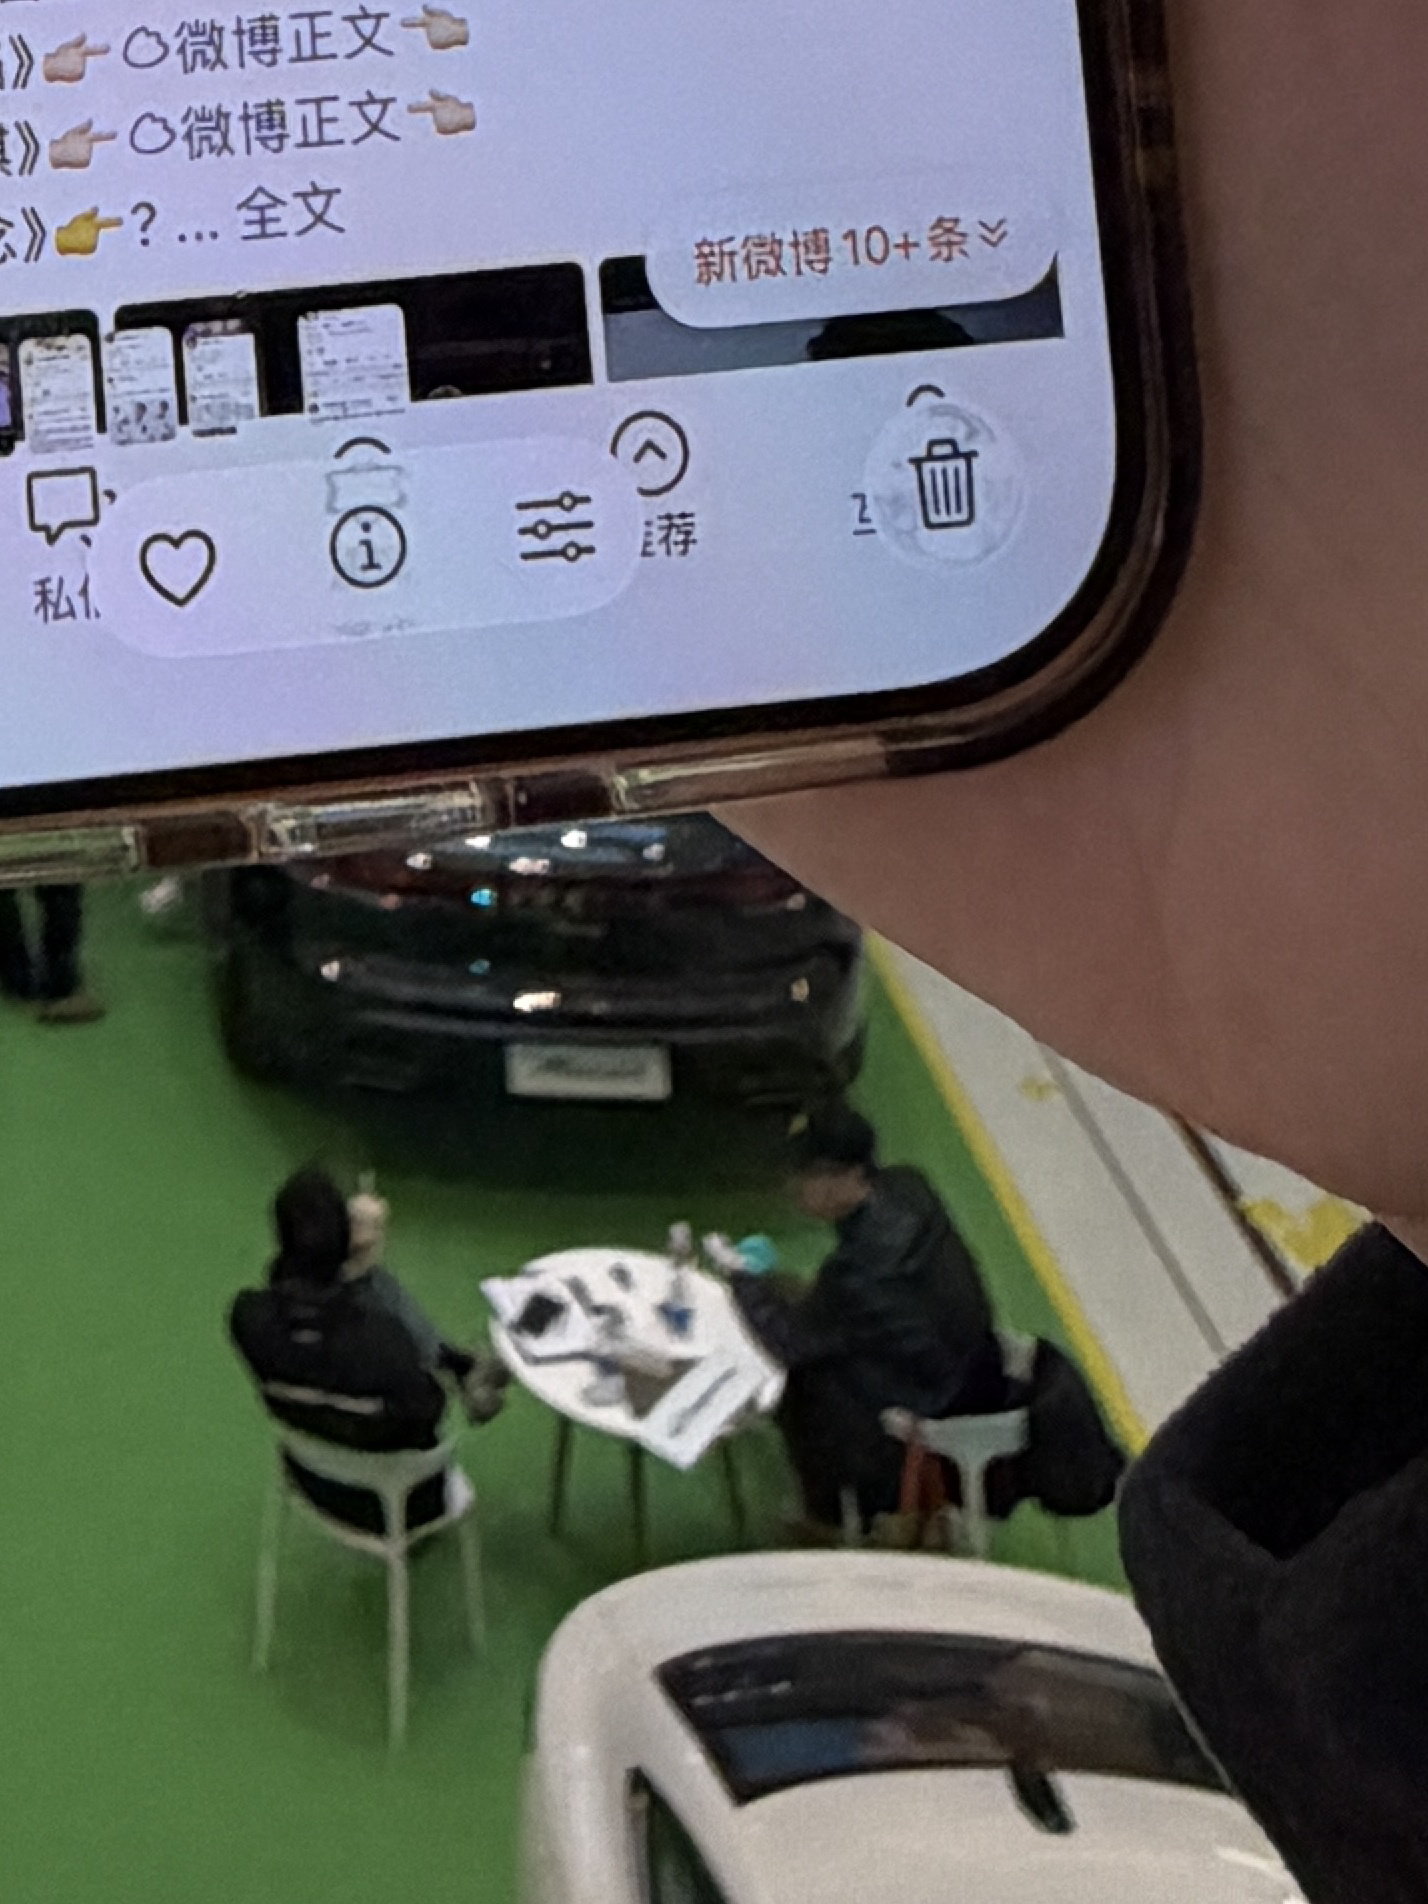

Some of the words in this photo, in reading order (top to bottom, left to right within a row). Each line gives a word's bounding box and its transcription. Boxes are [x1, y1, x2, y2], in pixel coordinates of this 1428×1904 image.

[173, 4, 396, 75] 微博正文
[180, 90, 402, 160] 微博正文
[235, 180, 346, 242] 全文
[693, 215, 971, 287] 新微博10+条
